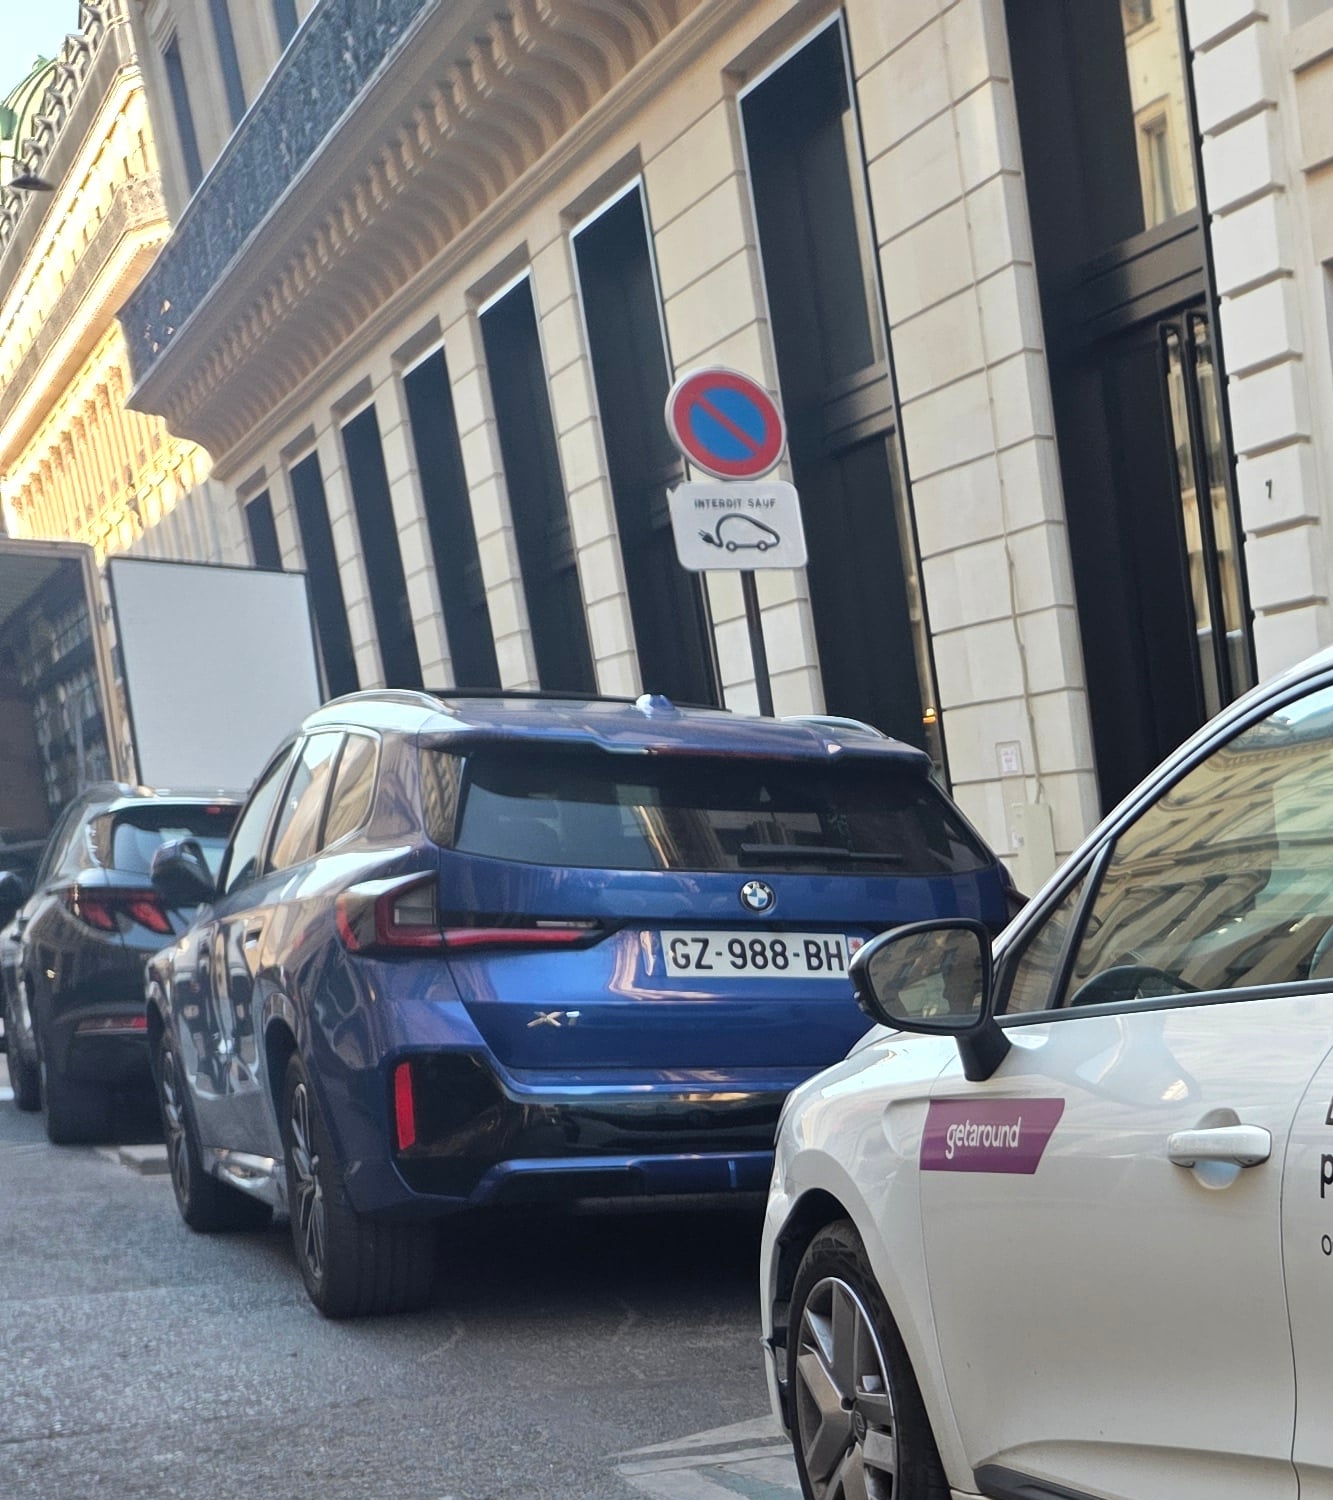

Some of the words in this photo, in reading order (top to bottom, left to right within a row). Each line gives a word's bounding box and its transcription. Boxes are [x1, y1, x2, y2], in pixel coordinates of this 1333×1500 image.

[694, 498, 742, 509] INTERDIT
[747, 498, 776, 508] SAUF
[670, 937, 845, 972] GZ-988-BH
[526, 1010, 581, 1028] X1
[945, 1116, 1022, 1160] getaround
